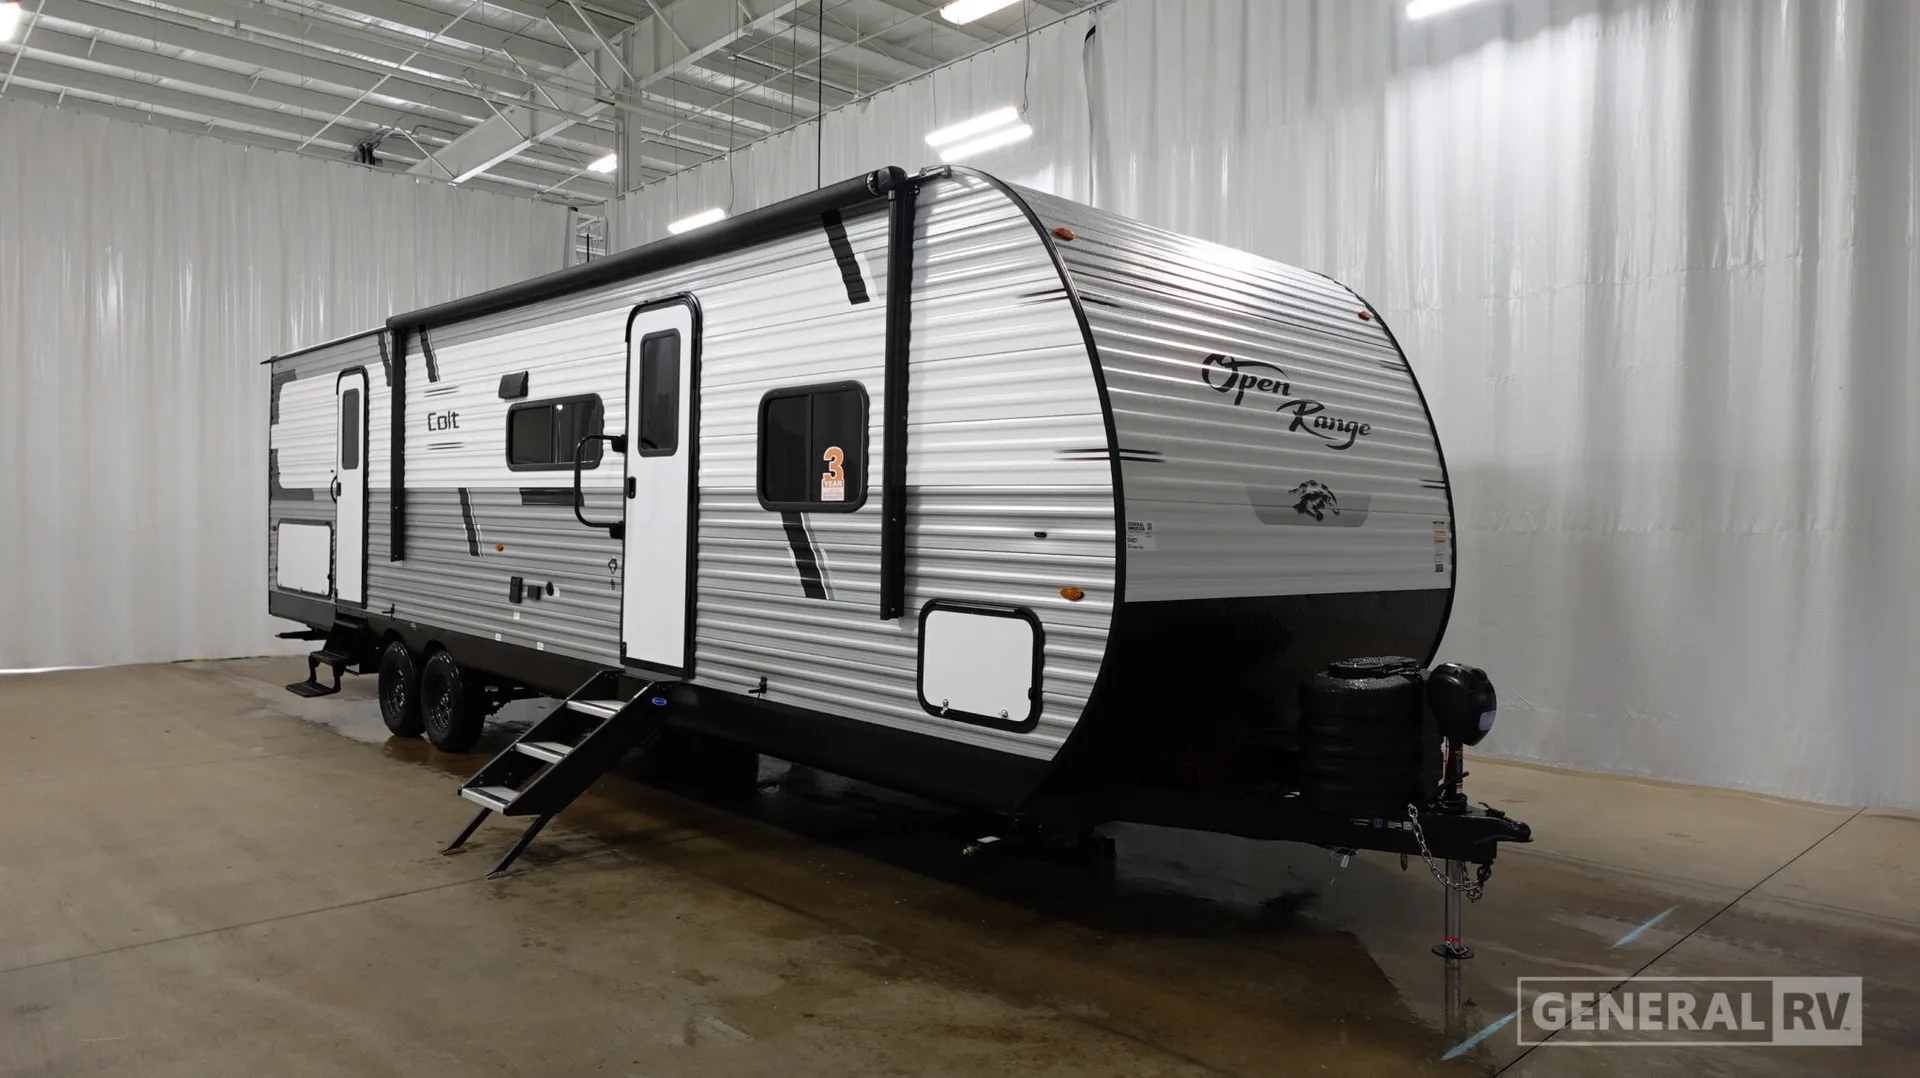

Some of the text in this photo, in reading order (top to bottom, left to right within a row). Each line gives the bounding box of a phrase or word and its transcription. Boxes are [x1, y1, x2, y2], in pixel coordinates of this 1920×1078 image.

[1202, 353, 1292, 405] Open
[428, 410, 460, 431] Colt
[1276, 399, 1371, 450] Range
[823, 446, 844, 480] 3
